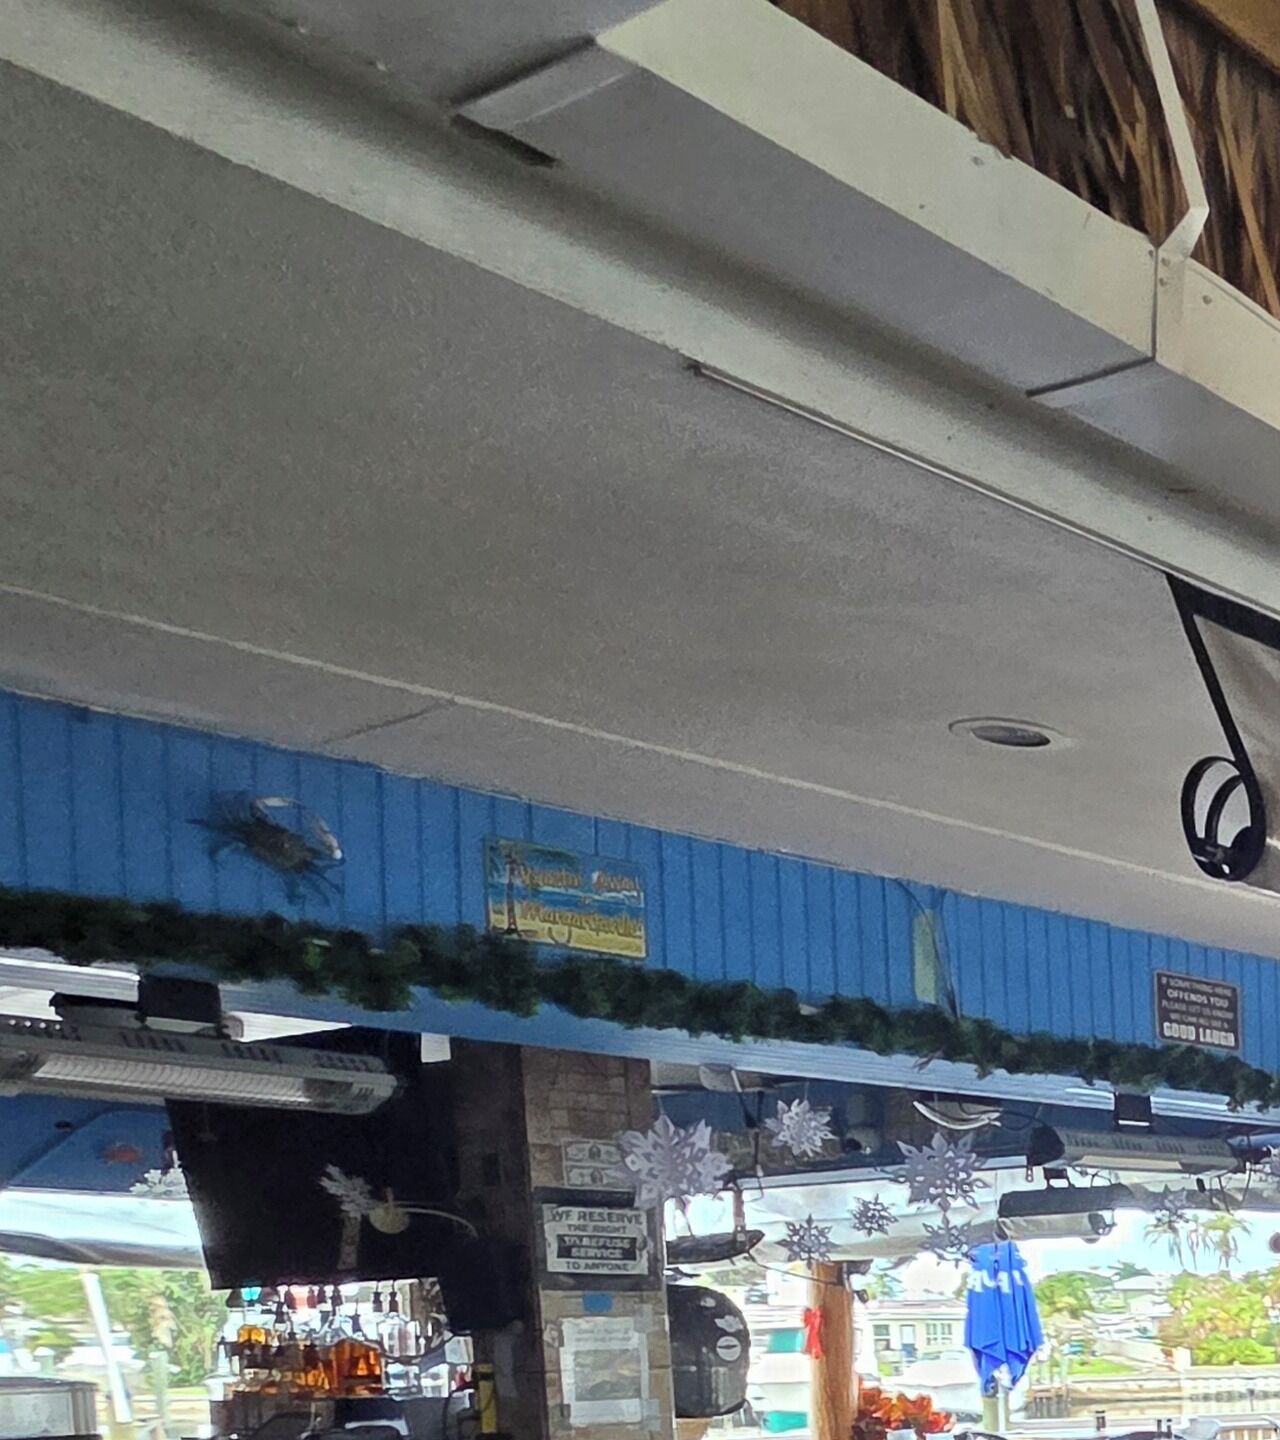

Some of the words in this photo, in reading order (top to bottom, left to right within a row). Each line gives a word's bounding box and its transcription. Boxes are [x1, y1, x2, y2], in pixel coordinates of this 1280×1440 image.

[1167, 988, 1208, 1004] OFFENDS
[1210, 996, 1229, 1008] YOU
[1162, 1000, 1187, 1011] PLEASE
[1163, 1021, 1196, 1041] GOOD
[1199, 1027, 1236, 1047] LAUGH
[552, 1208, 573, 1223] WE
[577, 1210, 643, 1225] RESERVE
[567, 1224, 587, 1233] THE
[592, 1225, 627, 1234] RIGHT
[582, 1237, 631, 1249] REFUSE
[571, 1247, 623, 1259] SERVICE
[565, 1261, 580, 1270] TO
[584, 1262, 631, 1271] ANYONE
